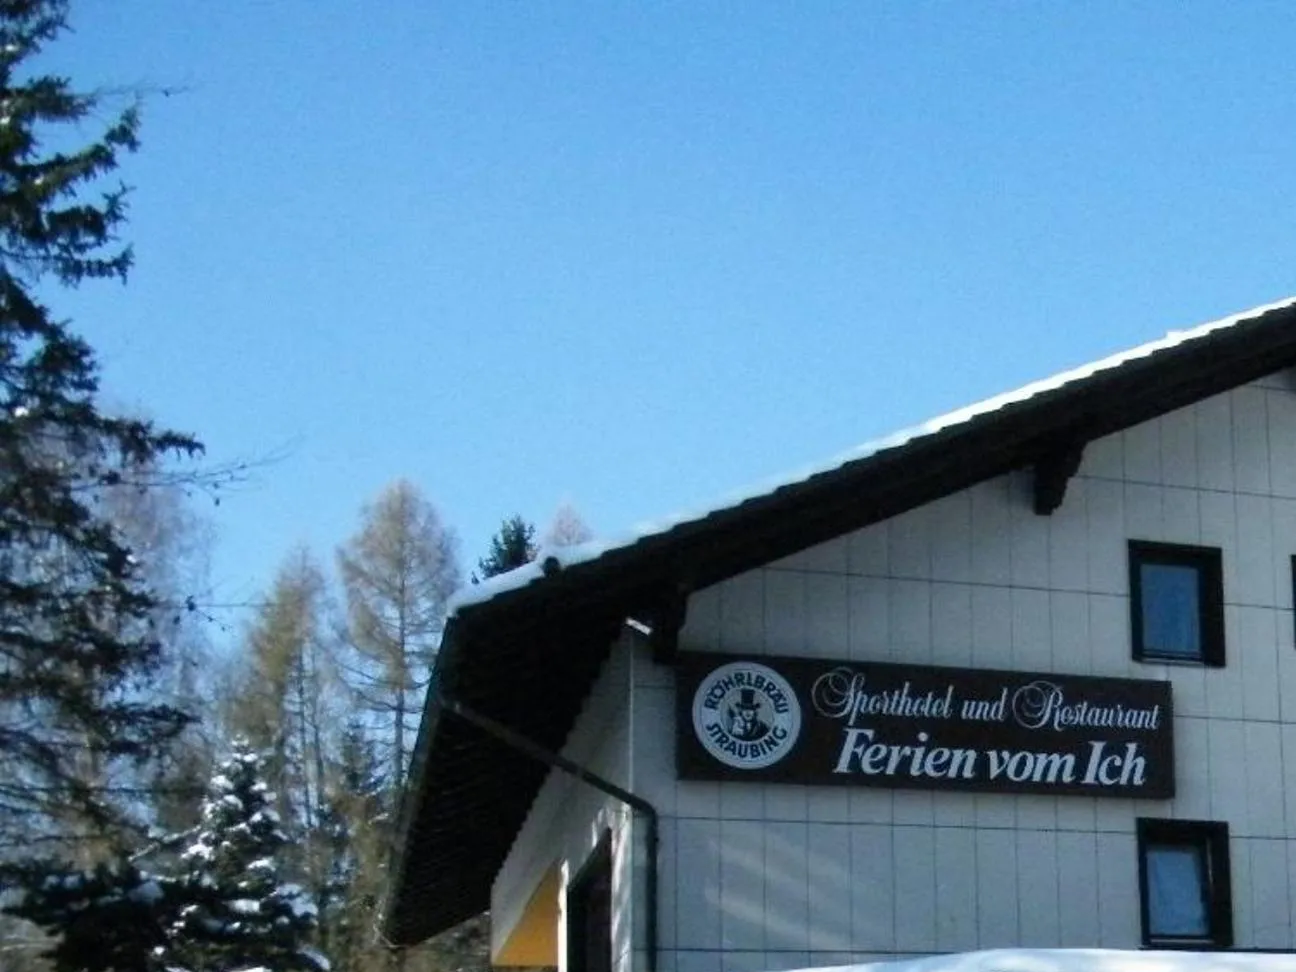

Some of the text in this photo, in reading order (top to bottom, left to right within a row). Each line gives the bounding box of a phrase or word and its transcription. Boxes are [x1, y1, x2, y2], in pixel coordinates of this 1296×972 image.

[811, 666, 1159, 732] Sporthotel und Restaurant
[706, 722, 788, 759] STRAUBING
[832, 727, 1147, 786] Ferien vom Ich
